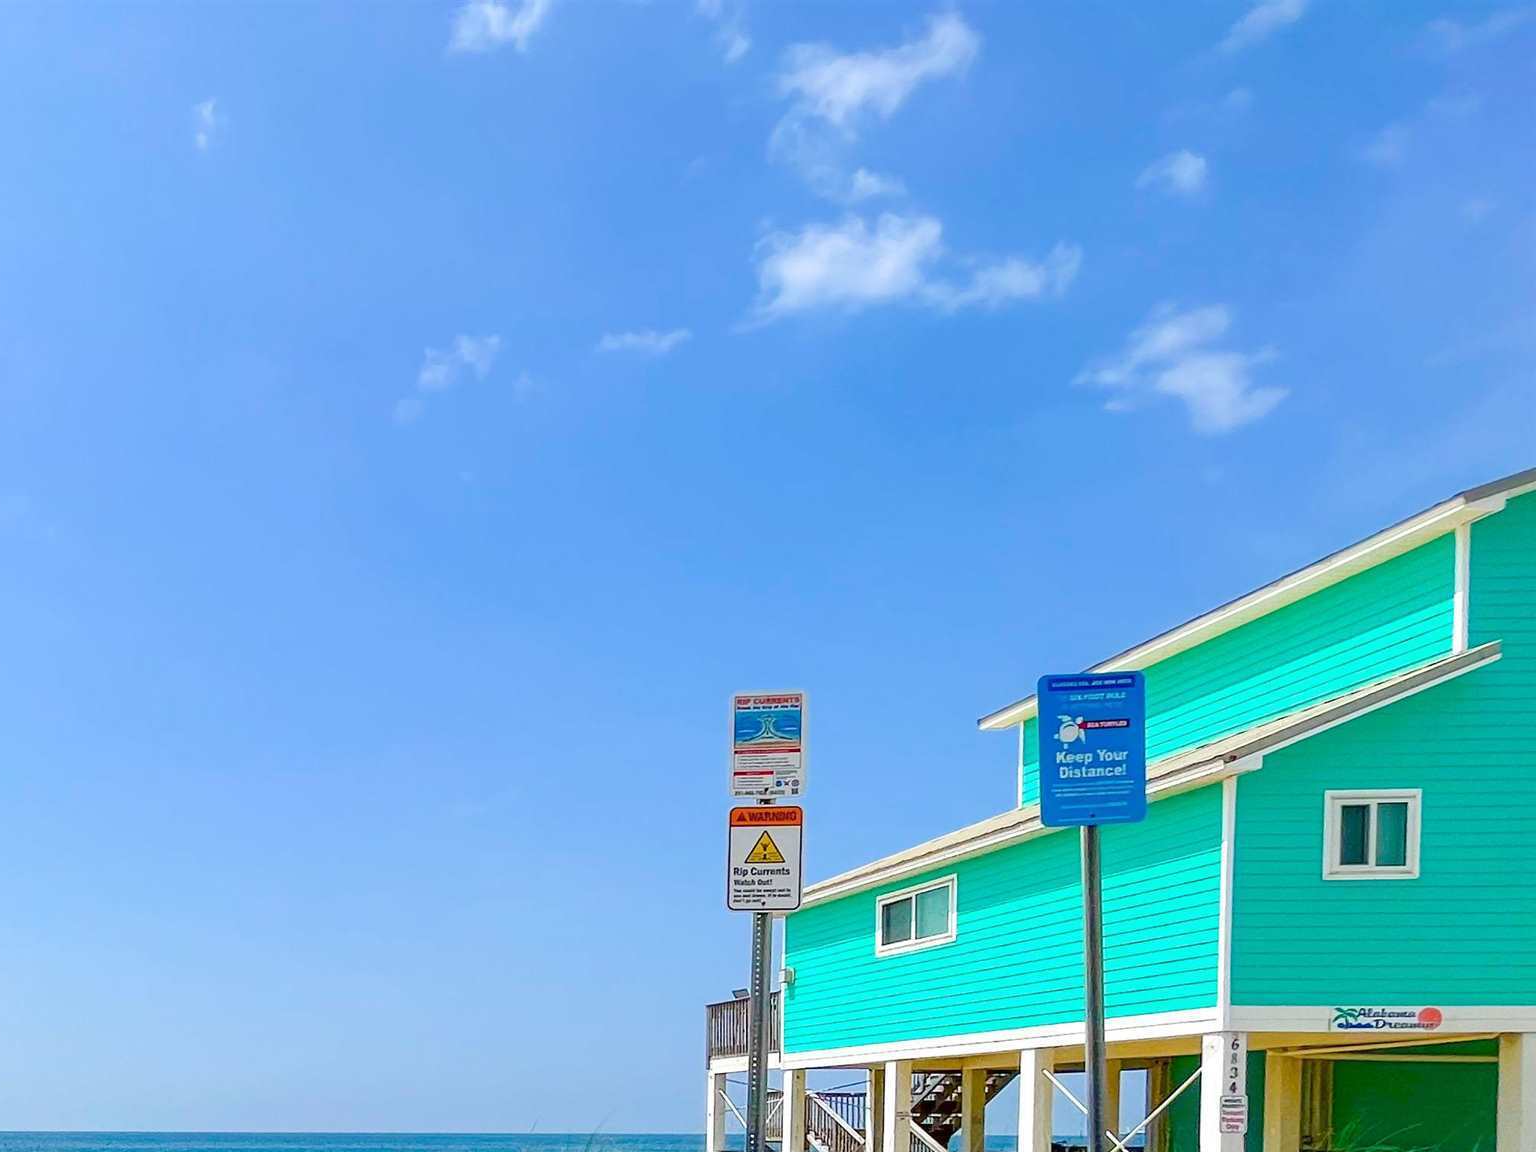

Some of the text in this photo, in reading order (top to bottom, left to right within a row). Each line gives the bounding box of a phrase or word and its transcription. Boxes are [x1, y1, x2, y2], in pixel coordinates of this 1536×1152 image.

[1056, 749, 1128, 765] Keep Your
[1059, 764, 1127, 779] Distance!
[748, 811, 796, 821] WARNING
[733, 866, 790, 877] Rip Currents
[1356, 1007, 1417, 1018] Alabama
